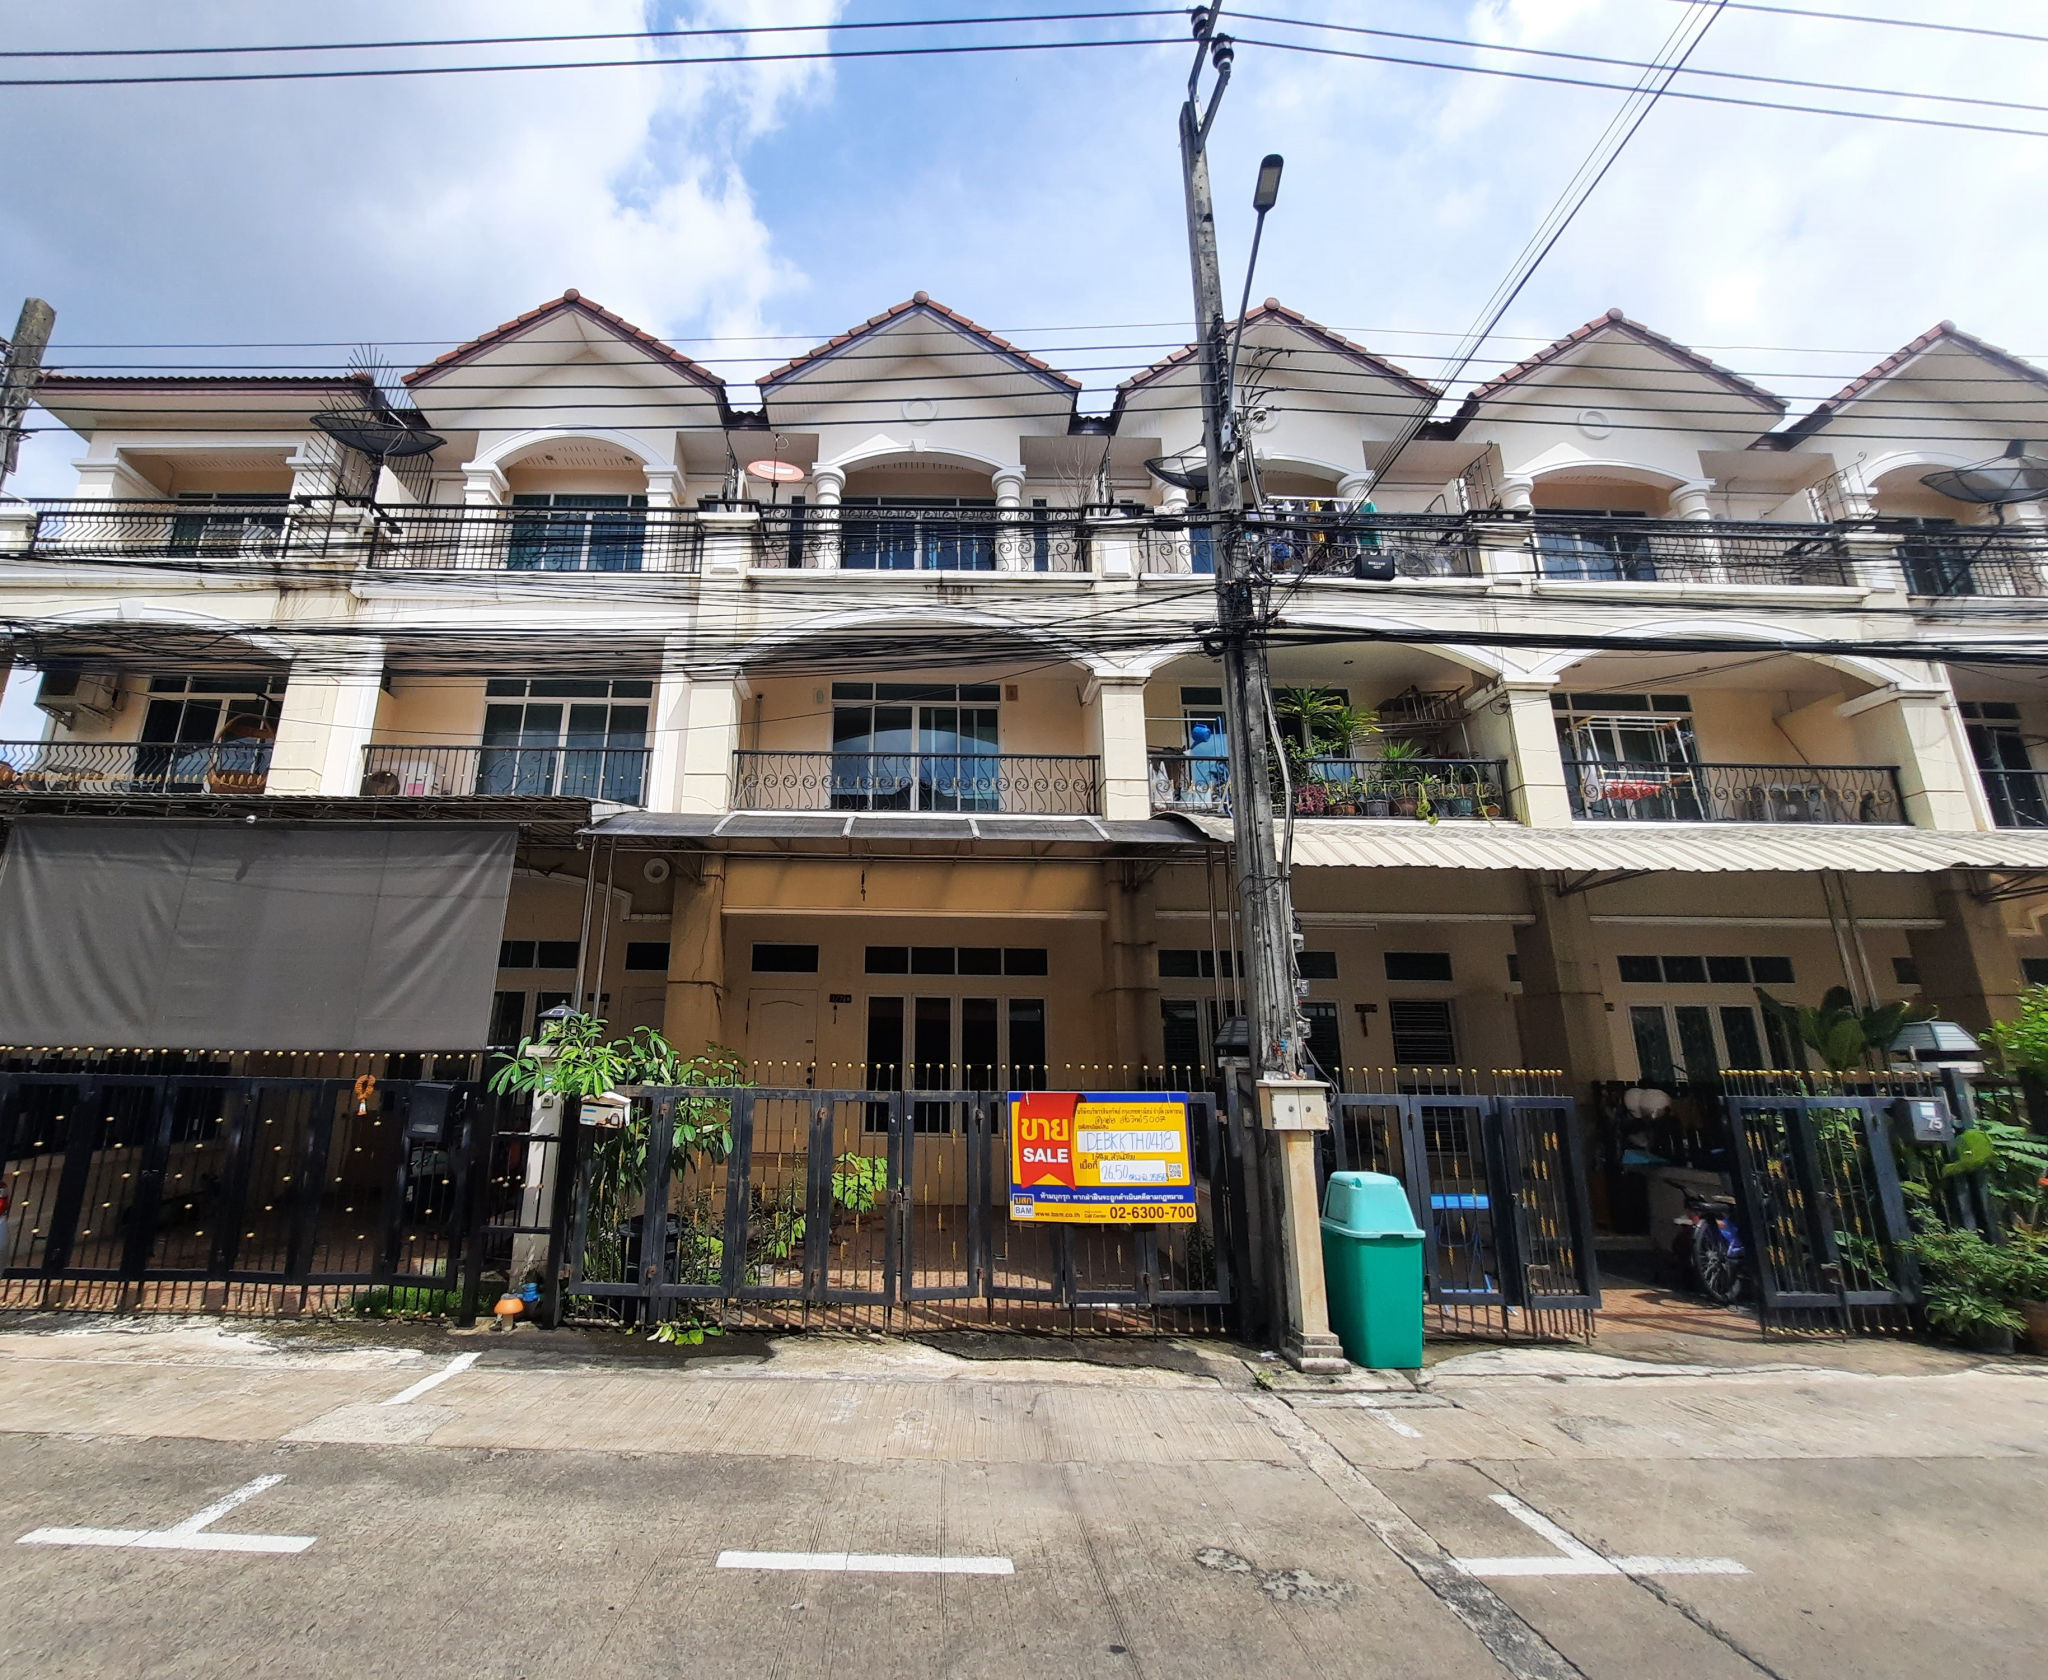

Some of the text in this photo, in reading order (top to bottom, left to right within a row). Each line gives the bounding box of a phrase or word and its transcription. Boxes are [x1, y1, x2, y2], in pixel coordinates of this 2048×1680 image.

[1021, 1118, 1069, 1141] ขาย
[1928, 1117, 1943, 1129] 75
[1087, 1131, 1174, 1151] DEBKKTH0418
[1023, 1147, 1069, 1163] SALE
[1015, 1196, 1032, 1205] บสก
[1015, 1206, 1032, 1215] BAM
[1110, 1206, 1194, 1219] 02-6300-700
